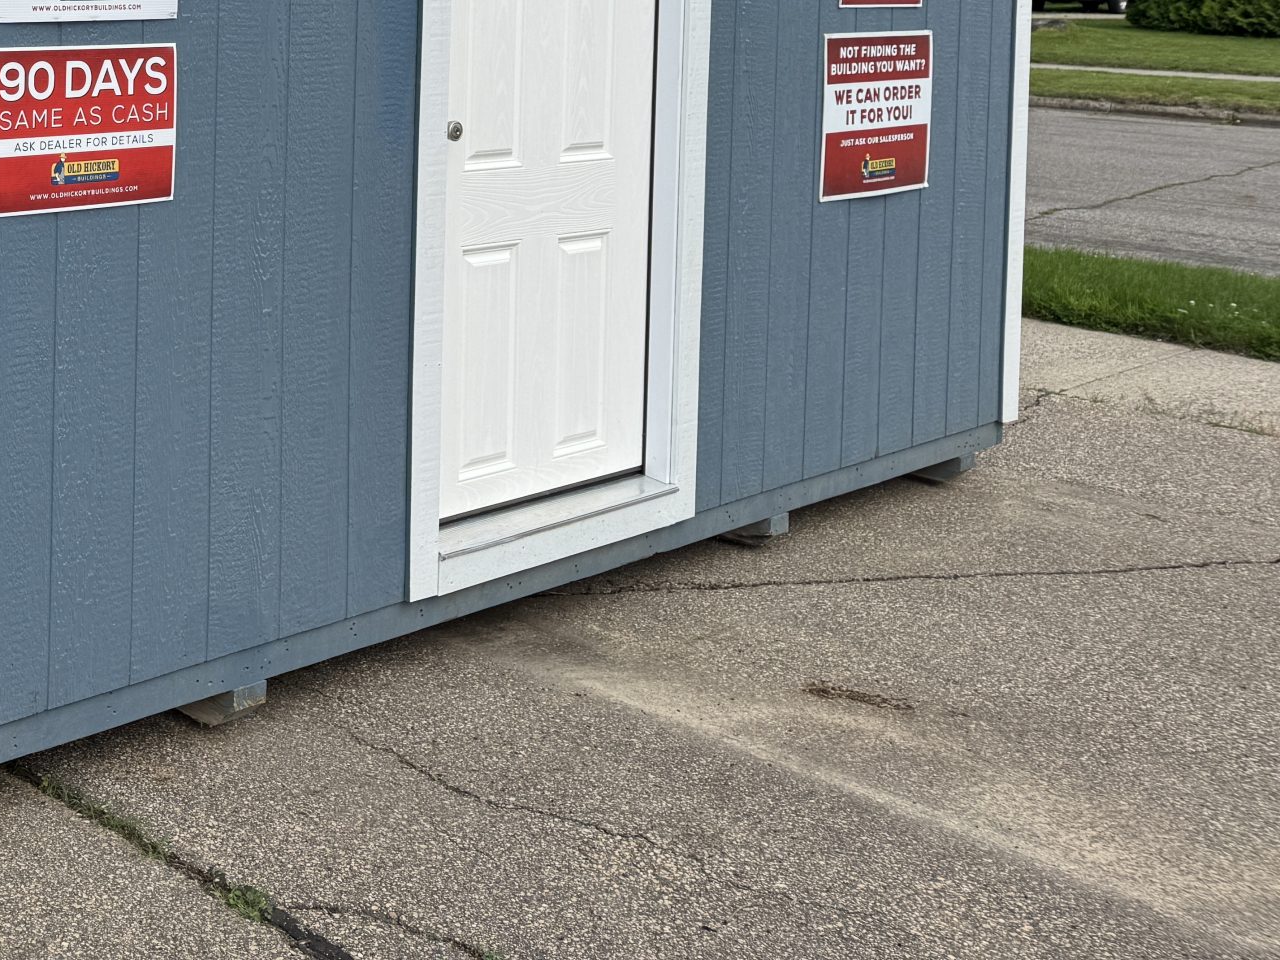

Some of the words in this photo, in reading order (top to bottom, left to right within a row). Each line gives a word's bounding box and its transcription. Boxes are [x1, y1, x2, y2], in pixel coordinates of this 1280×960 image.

[32, 4, 141, 12] WWW.OLDHICKORYBUILDINGS.COM
[840, 46, 859, 59] NOT
[861, 44, 897, 58] FINDING
[899, 44, 916, 55] THE
[830, 62, 874, 76] BUILDING
[876, 60, 893, 73] YOU
[896, 58, 926, 72] WANT?
[0, 60, 55, 102] 90
[64, 56, 168, 98] DAYS
[834, 89, 852, 106] WE
[856, 88, 880, 104] CAN
[884, 84, 922, 102] ORDER
[0, 108, 63, 131] SAME
[73, 106, 102, 127] AS
[112, 102, 168, 124] CASH
[846, 110, 856, 126] IT
[860, 107, 883, 124] FOR
[886, 104, 912, 121] YOU!
[14, 141, 36, 152] ASK
[39, 138, 82, 151] DEALER
[86, 136, 108, 148] FOR
[112, 134, 153, 146] DETAILS
[840, 138, 854, 147] JUST
[855, 136, 866, 146] ASK
[868, 136, 879, 145] OUR
[880, 132, 914, 144] SALESPERSON
[67, 163, 82, 174] OLD
[84, 160, 116, 173] HICKORY
[77, 174, 106, 182] BUILDINGS
[30, 185, 138, 200] WWW.OLDHICKORYBUILDINGS.COM
